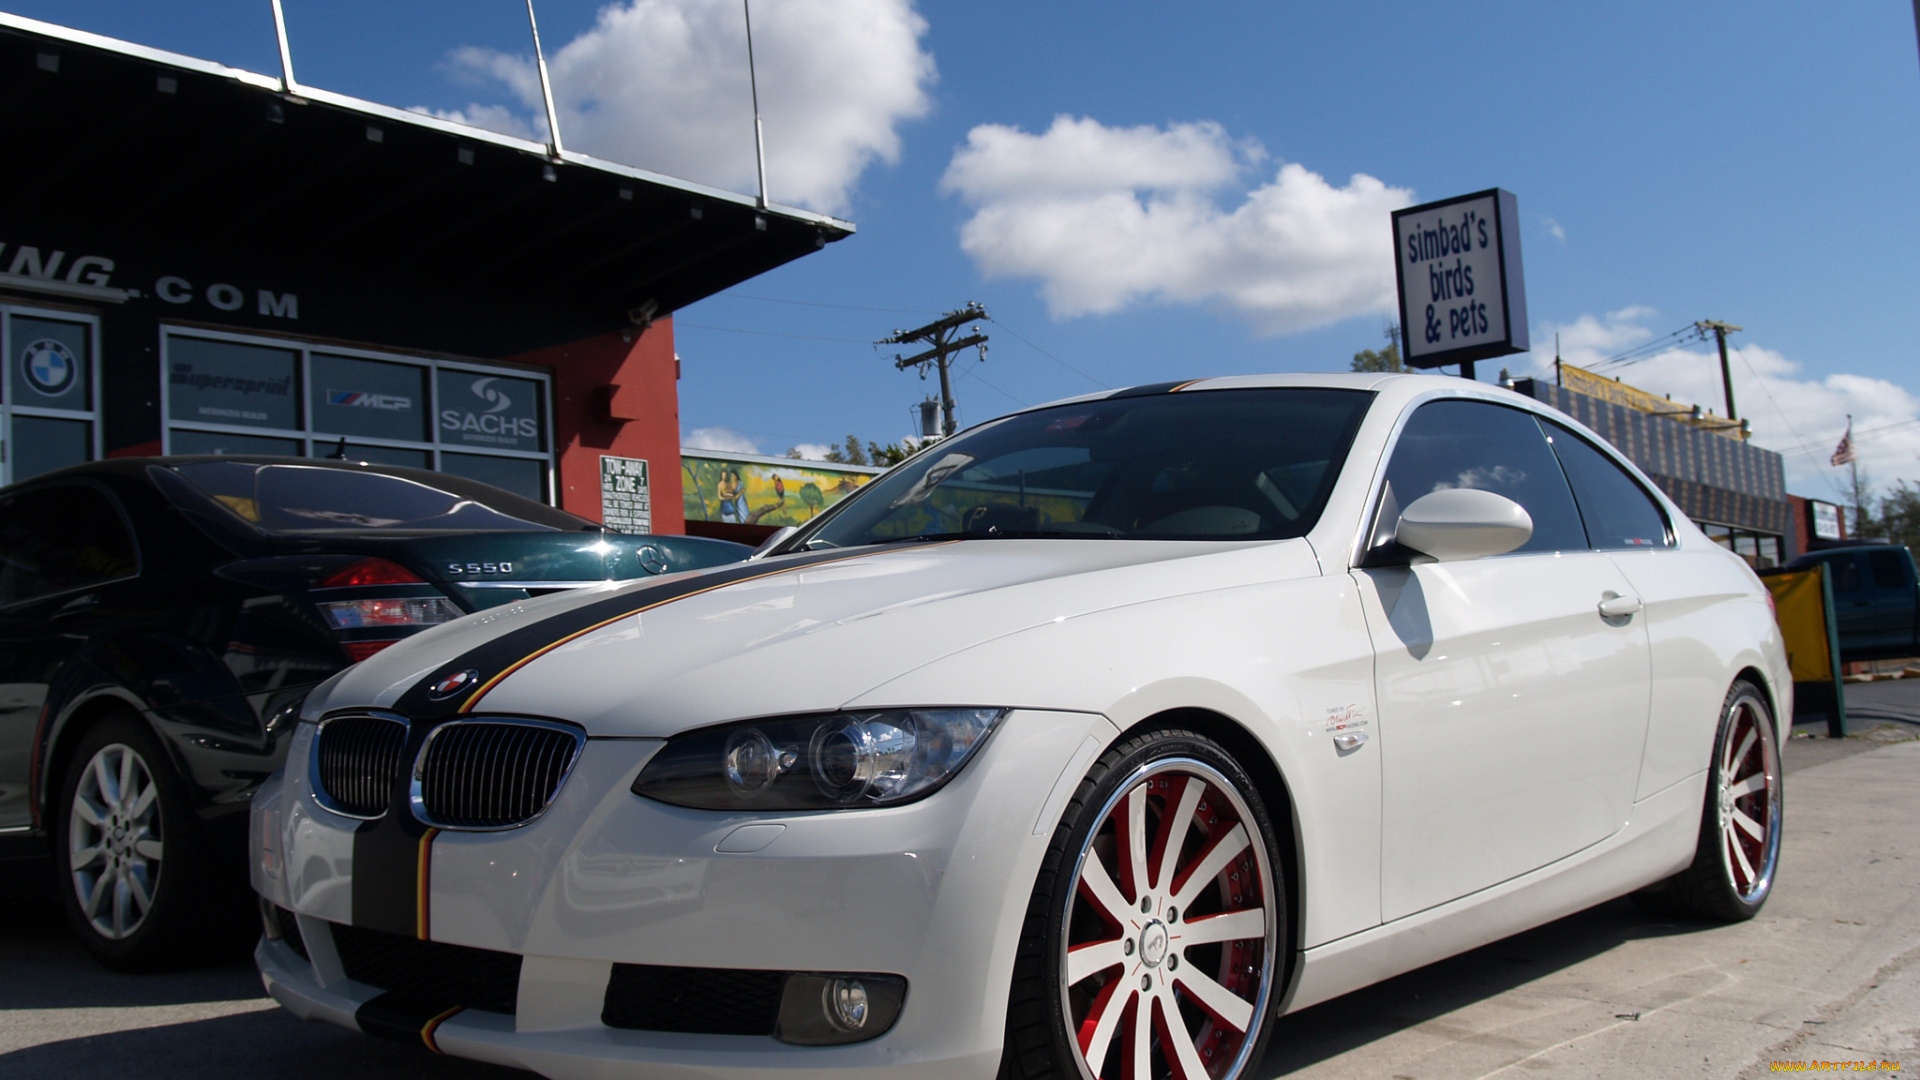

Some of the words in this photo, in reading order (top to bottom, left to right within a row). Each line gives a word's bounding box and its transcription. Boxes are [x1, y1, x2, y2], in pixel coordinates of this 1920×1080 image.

[1408, 211, 1488, 264] simbad's
[1429, 258, 1475, 302] birds
[1425, 303, 1442, 344] &
[1449, 299, 1488, 339] pets
[440, 409, 538, 438] SACHS
[615, 475, 636, 493] ZONE
